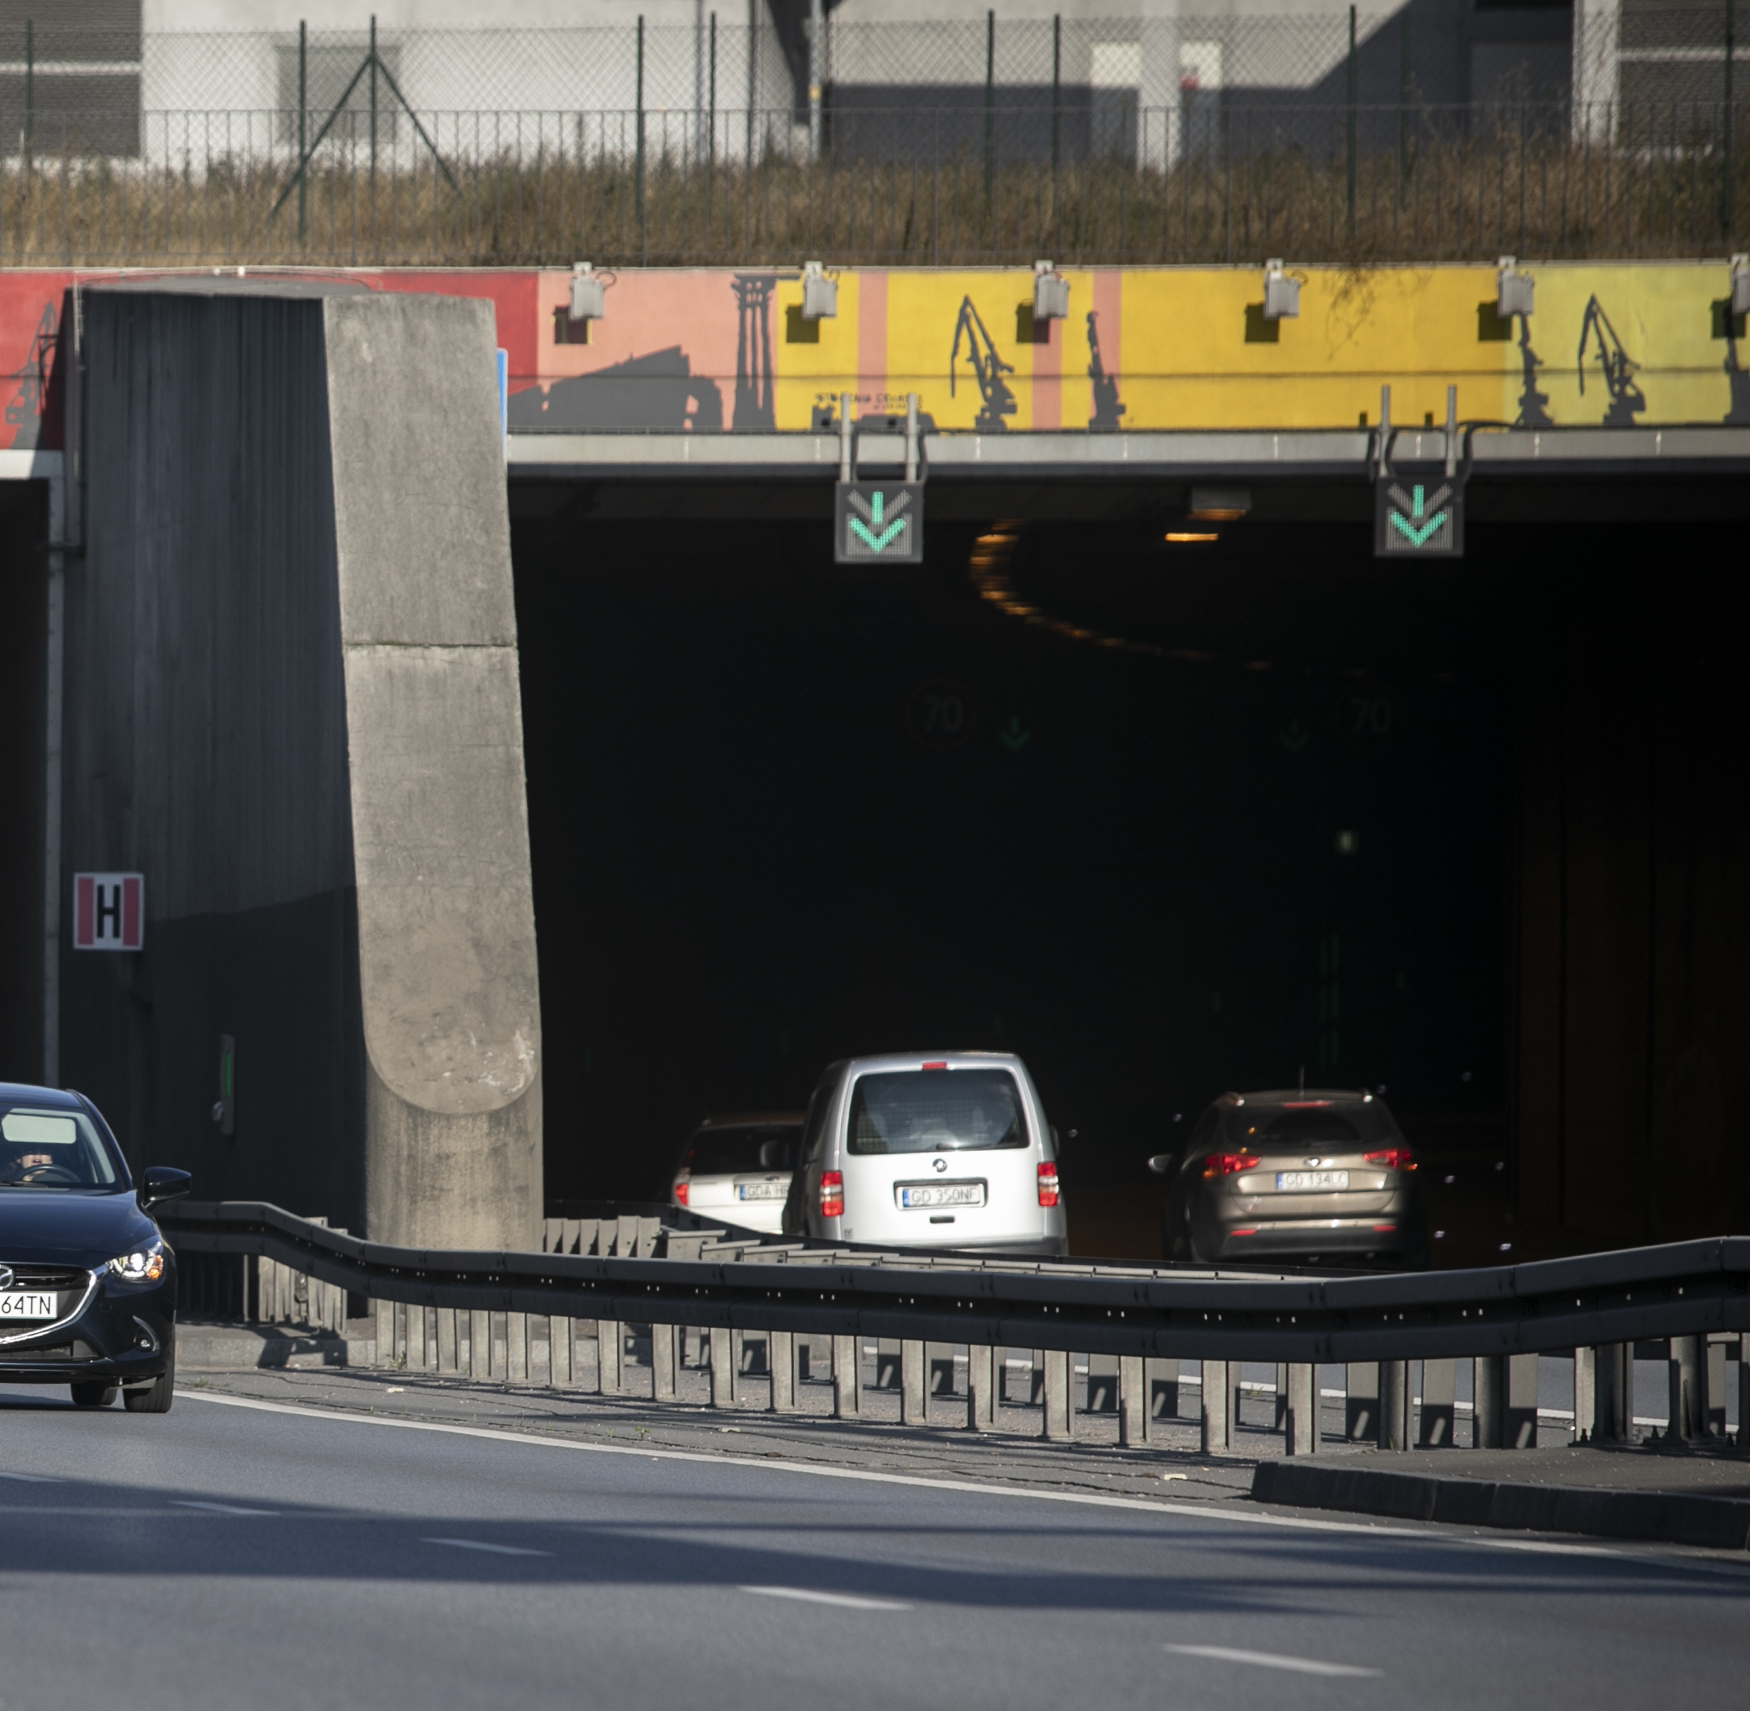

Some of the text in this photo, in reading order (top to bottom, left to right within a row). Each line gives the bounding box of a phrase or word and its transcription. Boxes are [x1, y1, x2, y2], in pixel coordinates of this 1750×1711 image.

[922, 694, 964, 734] 70
[1352, 697, 1394, 736] 70
[97, 884, 121, 938] H
[911, 1190, 931, 1203] GD
[1286, 1172, 1303, 1186] GD
